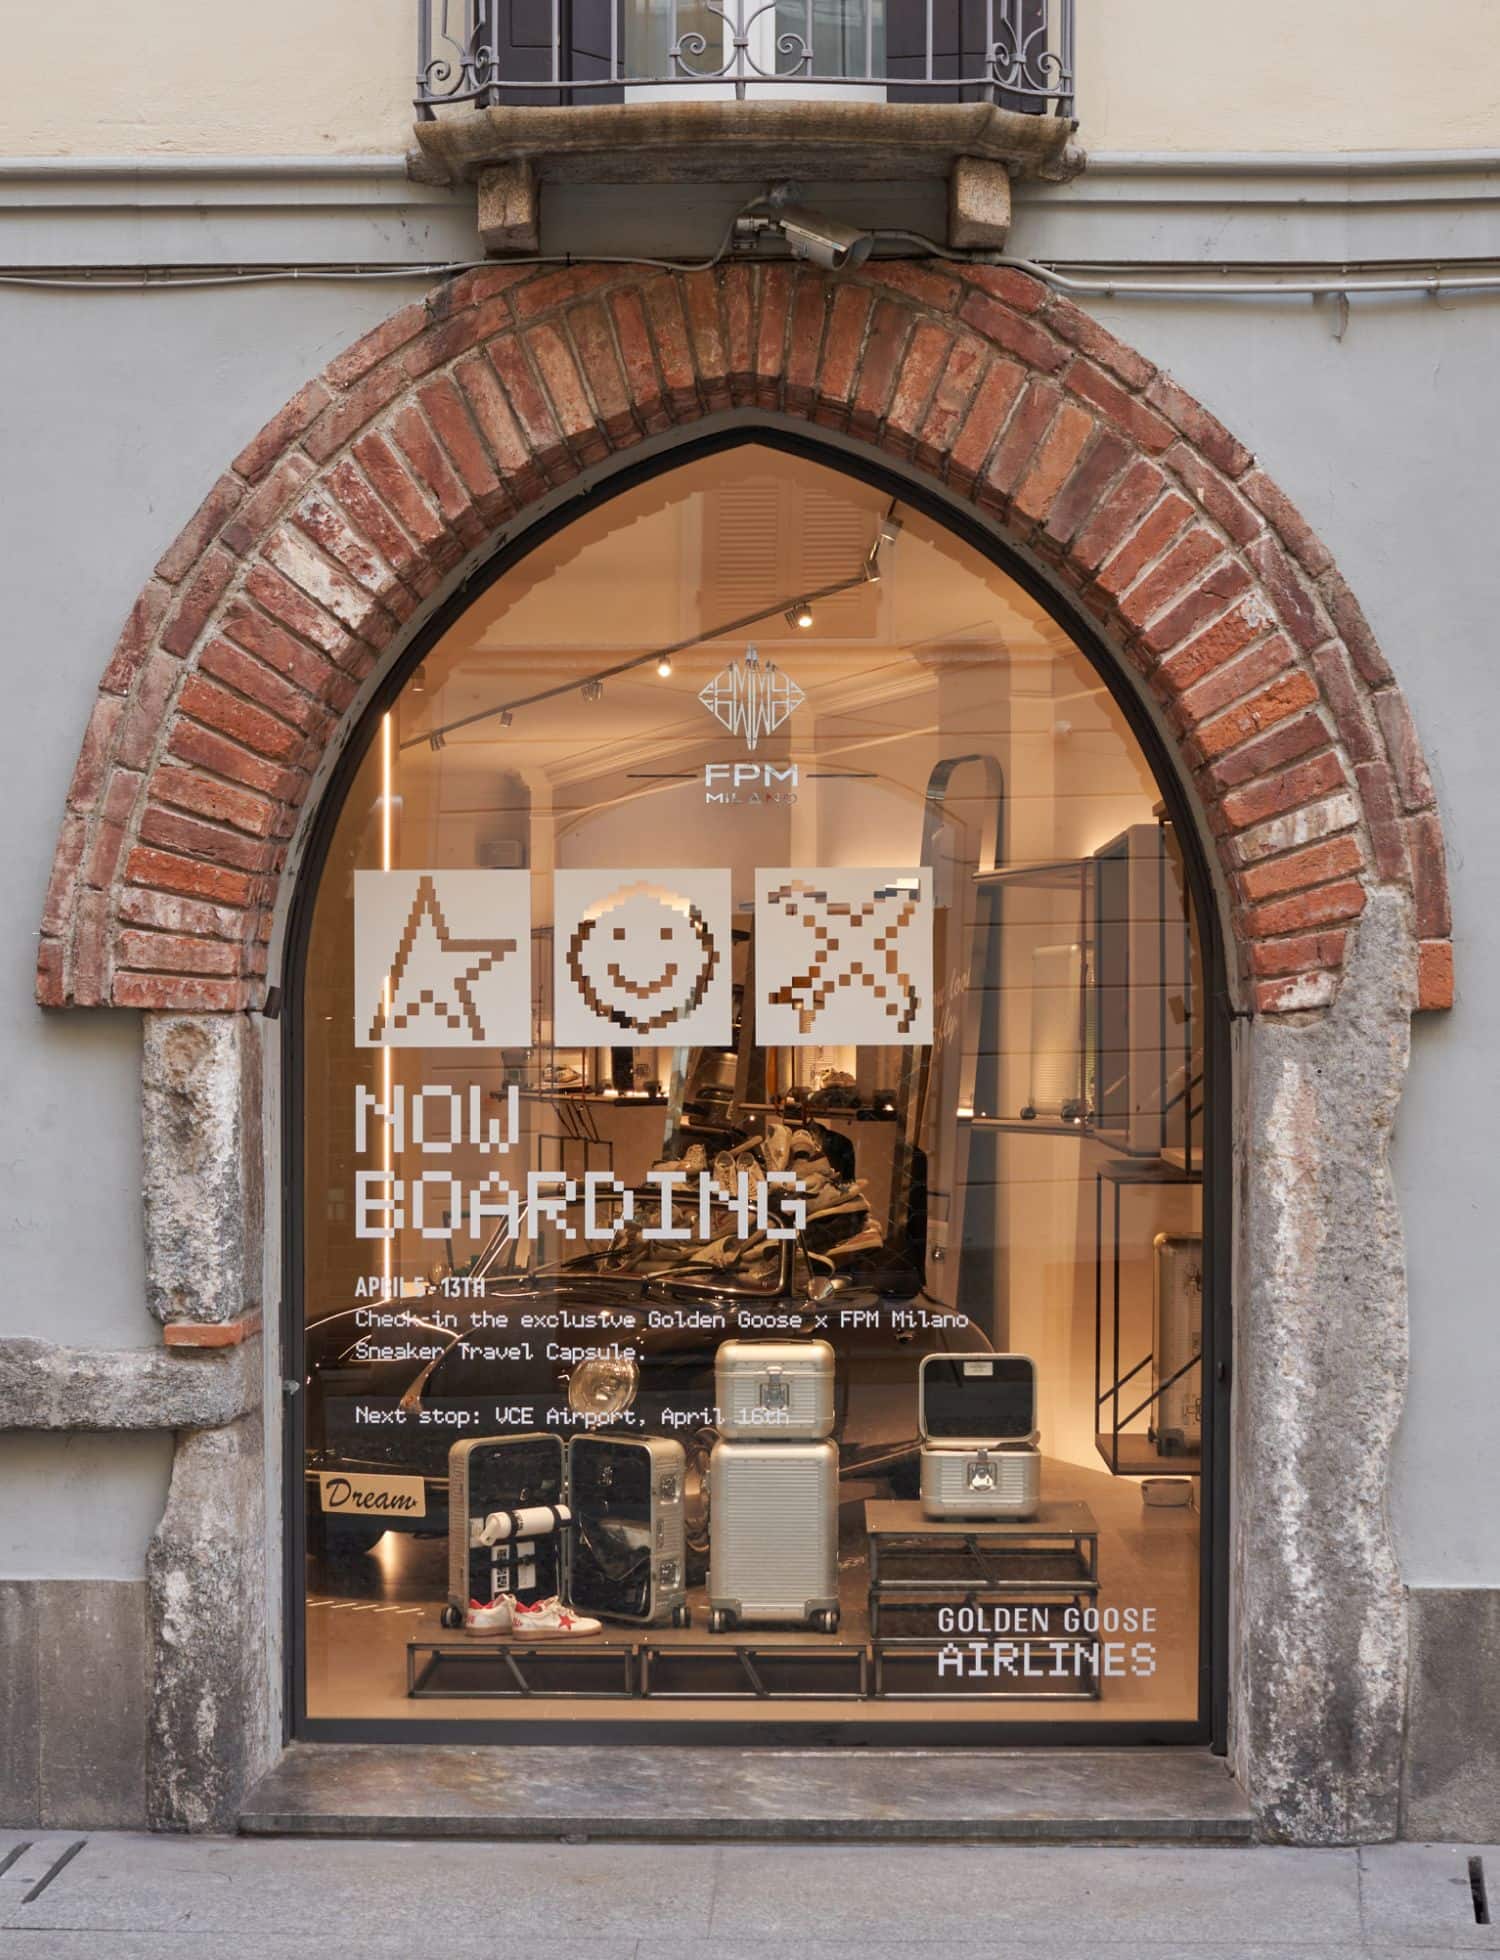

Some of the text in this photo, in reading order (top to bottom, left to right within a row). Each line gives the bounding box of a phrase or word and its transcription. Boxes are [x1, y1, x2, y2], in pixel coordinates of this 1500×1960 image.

[705, 764, 798, 786] FPM
[355, 1085, 519, 1153] NOW
[355, 1171, 807, 1239] BOARDING
[355, 1276, 408, 1298] APRIL
[355, 1310, 969, 1329] Check-in the exclusive Golden Goose x FPM Milano
[355, 1342, 646, 1364] Sneaker Travel Capsule.
[355, 1406, 407, 1425] Next
[418, 1407, 481, 1428] stop:
[495, 1406, 534, 1425] VCE
[546, 1406, 647, 1428] Airport,
[661, 1408, 725, 1429] April
[326, 1478, 417, 1511] Dream
[938, 1607, 1157, 1632] GOLDEN GOOSE
[938, 1642, 1157, 1677] AIRLINES
